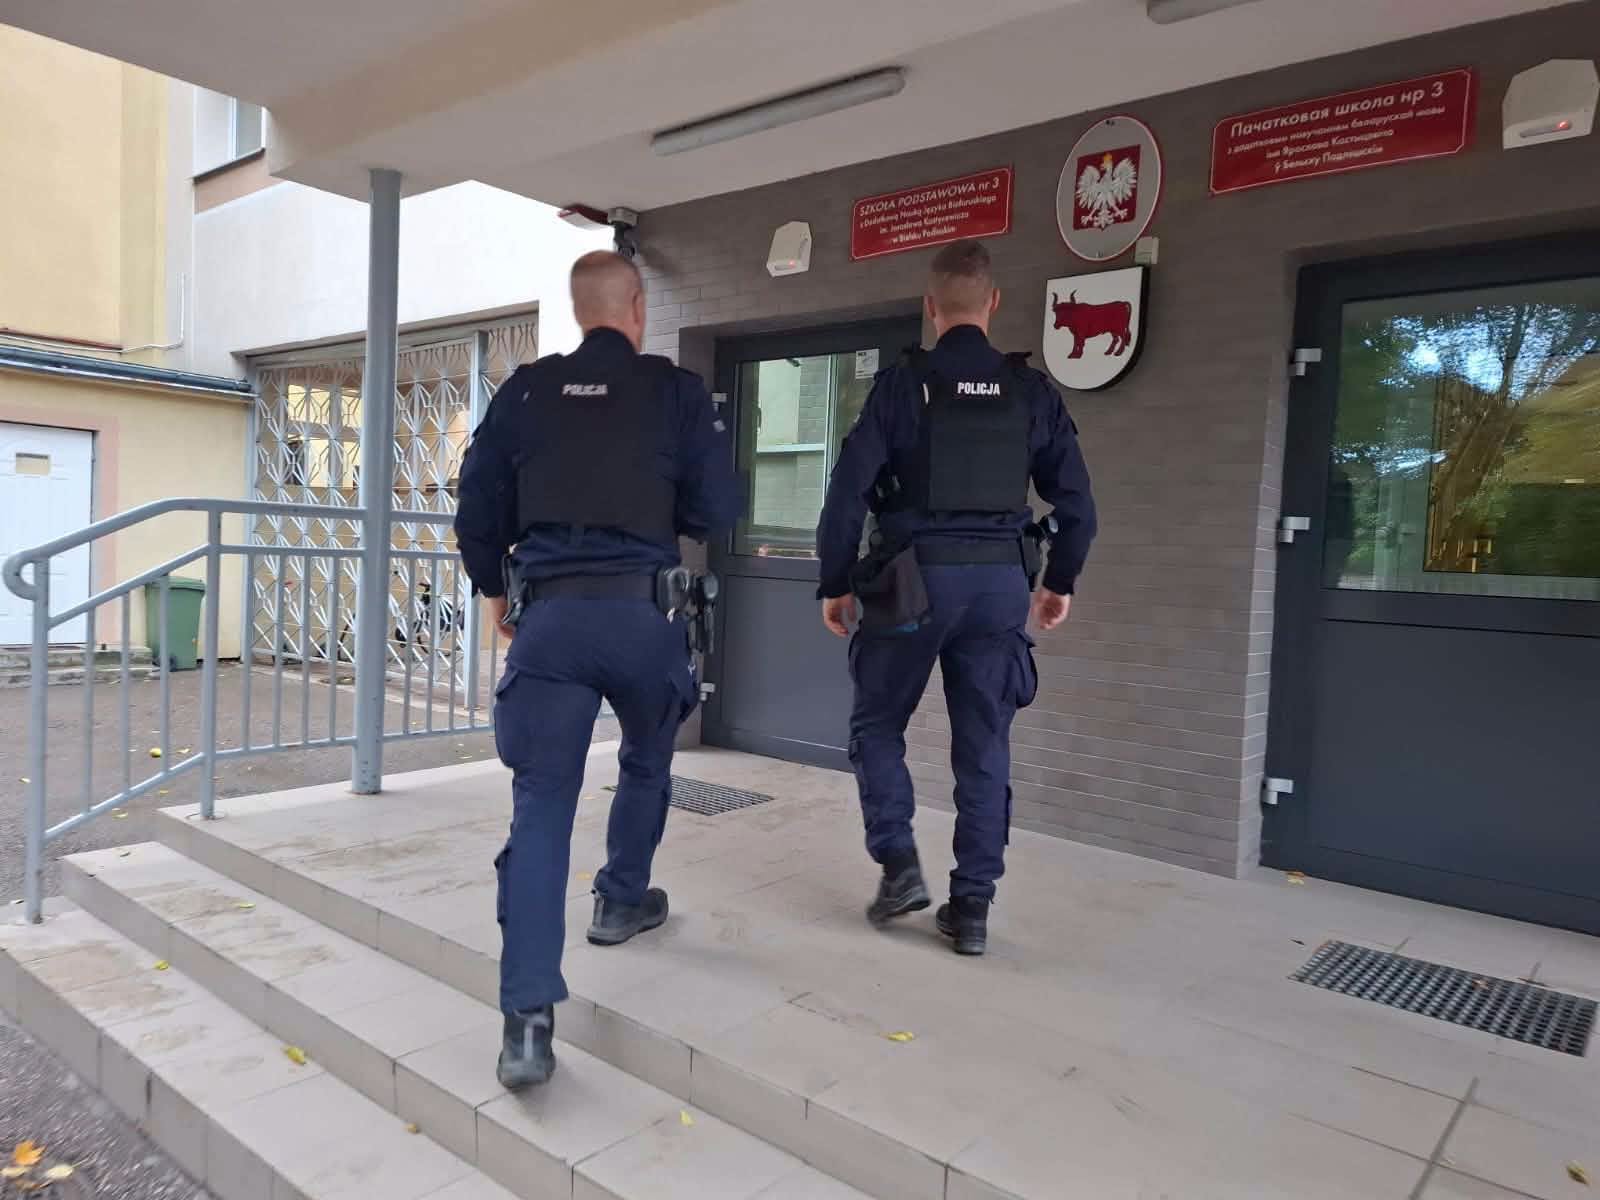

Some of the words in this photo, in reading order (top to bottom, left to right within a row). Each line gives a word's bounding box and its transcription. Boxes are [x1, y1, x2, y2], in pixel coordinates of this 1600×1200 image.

[1231, 107, 1330, 138] Пачатковая
[1335, 95, 1394, 116] школа
[1401, 89, 1425, 106] нр
[1431, 81, 1444, 98] 3
[859, 200, 896, 217] SZKOŁA
[898, 183, 976, 207] PODSTAWOWA
[978, 182, 990, 191] nr
[992, 176, 1000, 189] 3
[957, 381, 1000, 396] POLICJA
